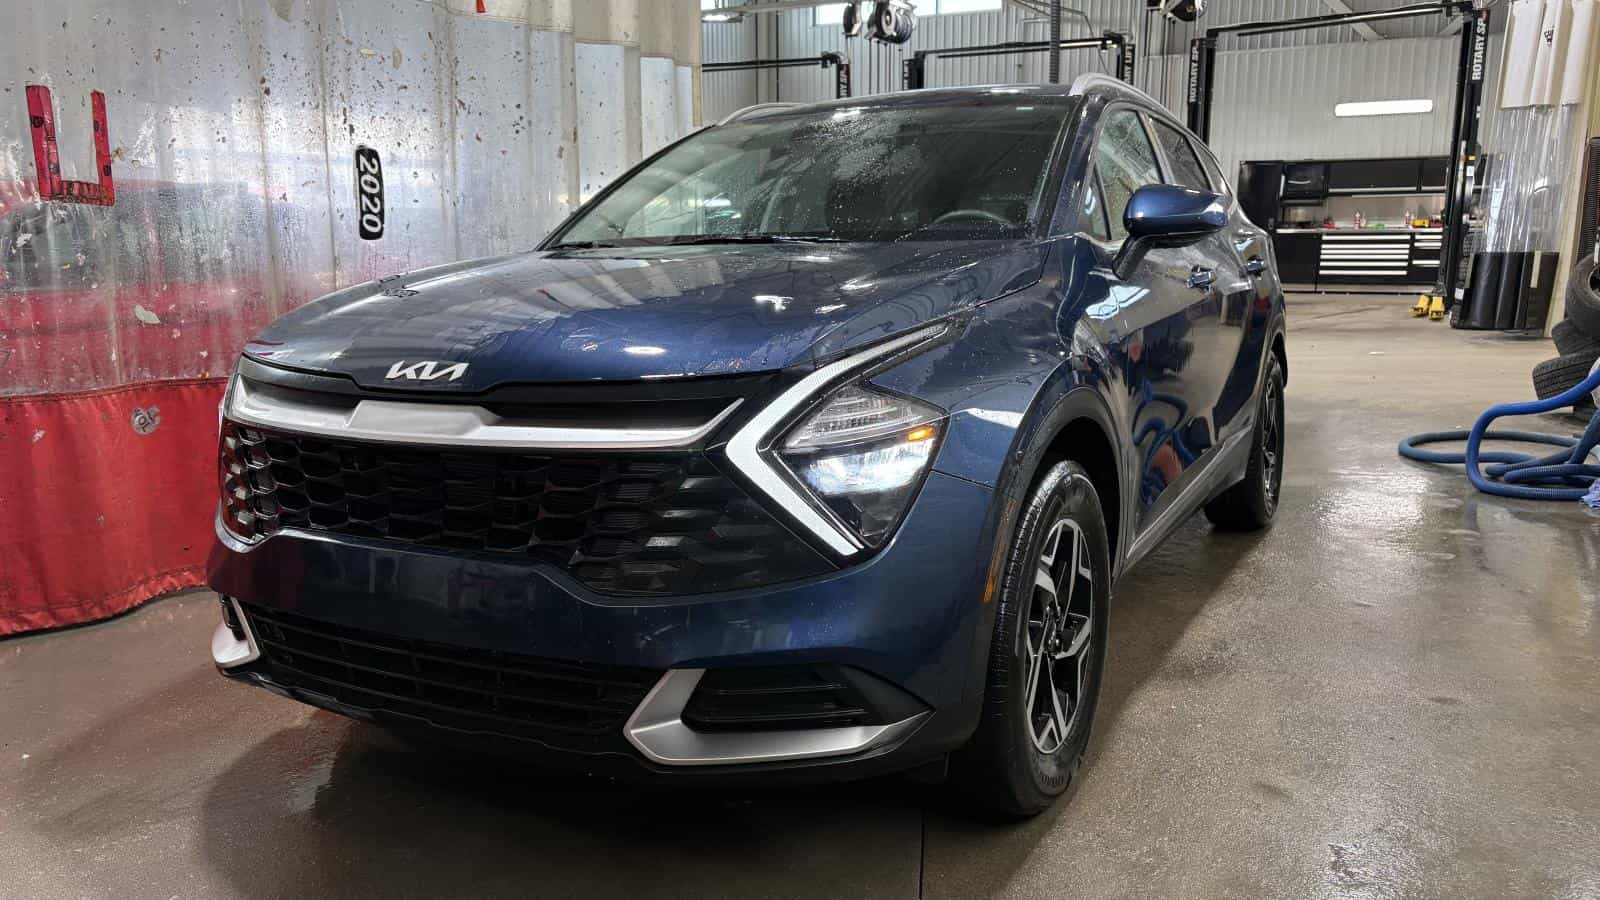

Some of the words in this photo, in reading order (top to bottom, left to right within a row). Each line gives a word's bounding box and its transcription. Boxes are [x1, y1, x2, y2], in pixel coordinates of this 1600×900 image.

[1124, 45, 1134, 64] LIFT
[1471, 34, 1485, 81] ROTARY
[1189, 62, 1199, 103] ROTARY
[359, 153, 382, 233] 2020
[384, 360, 470, 382] KIA
